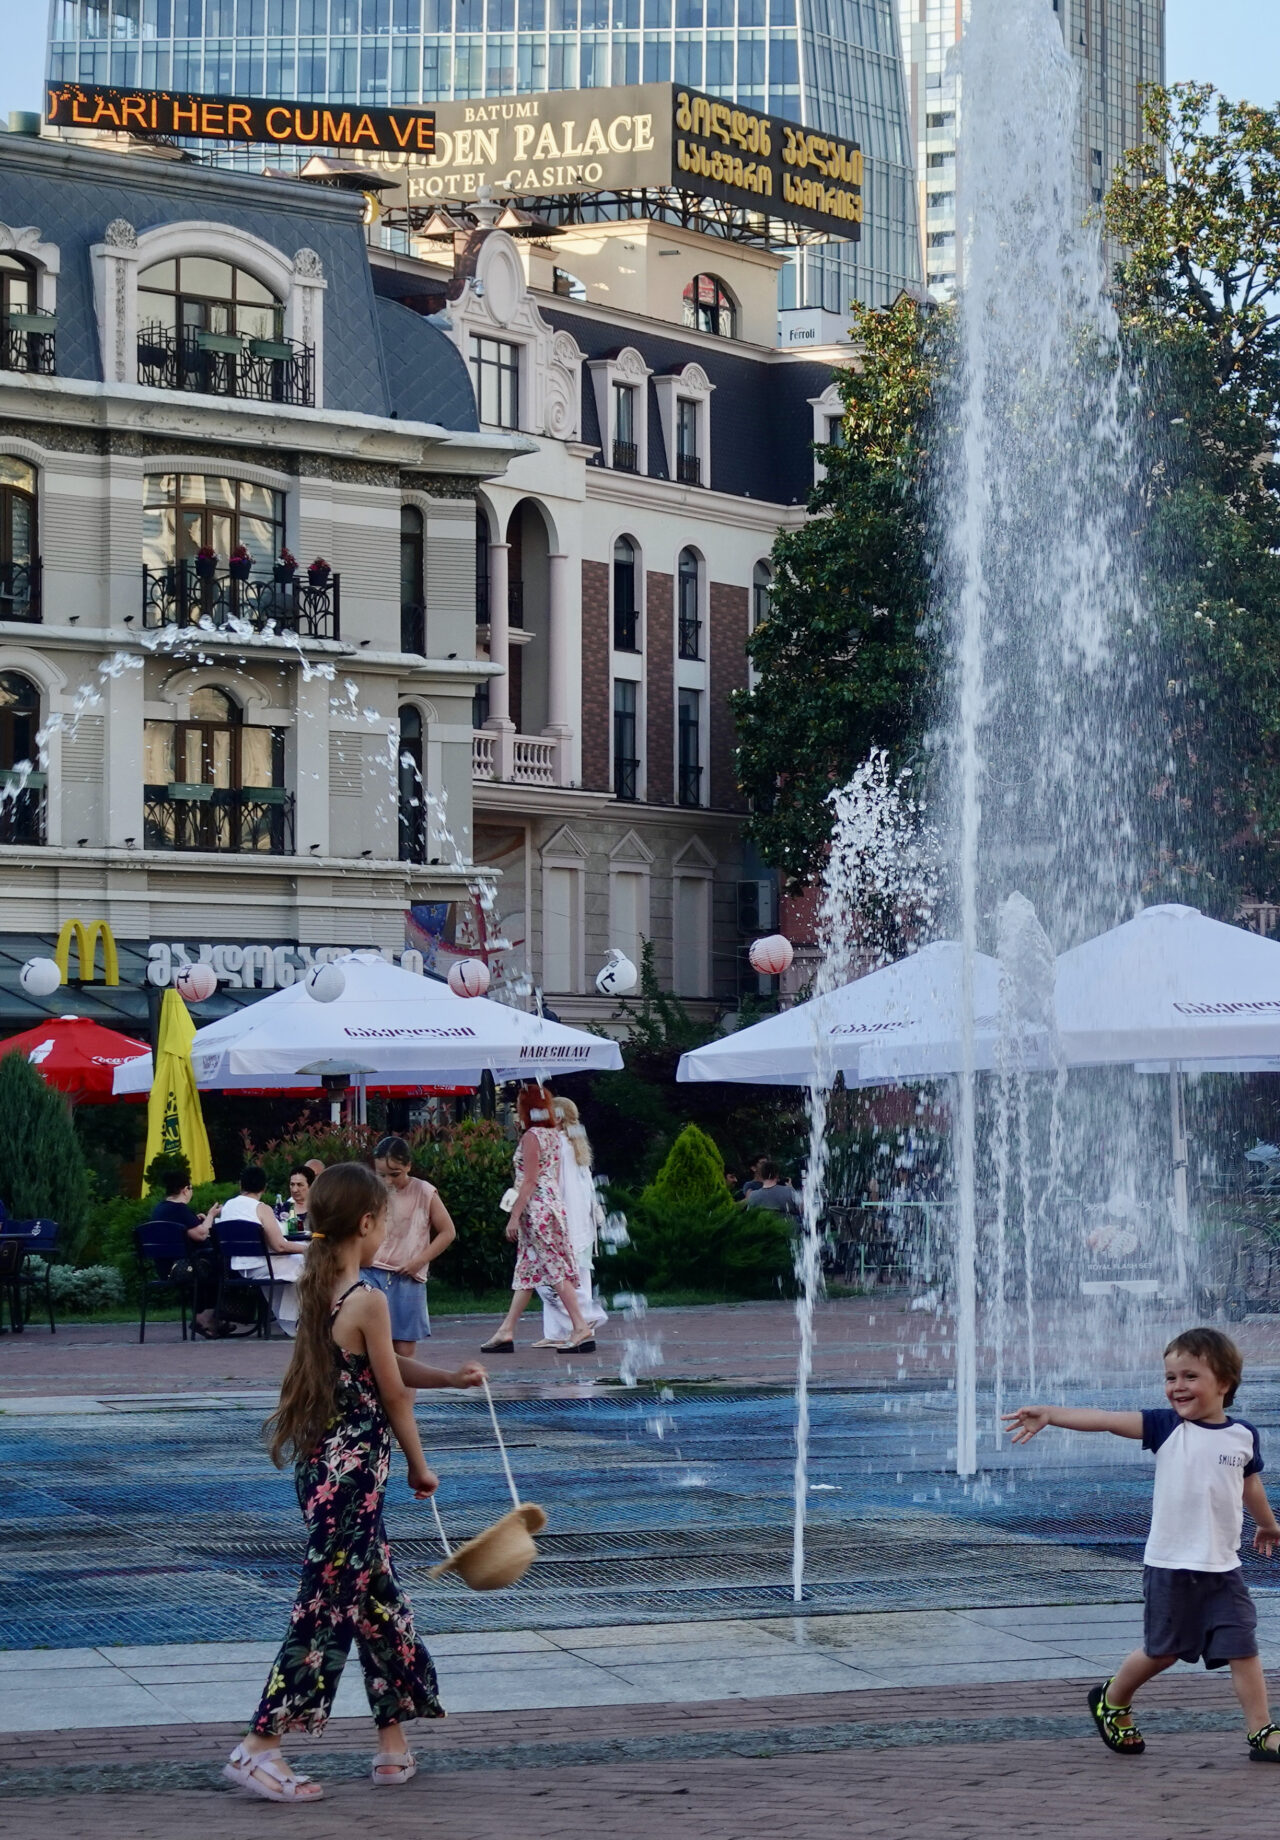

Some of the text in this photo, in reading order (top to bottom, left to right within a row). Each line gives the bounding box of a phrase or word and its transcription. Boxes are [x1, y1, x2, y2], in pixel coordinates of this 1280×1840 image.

[173, 100, 253, 137] HER
[266, 106, 380, 145] CUMA
[388, 115, 434, 149] VE
[464, 101, 540, 123] BATUMI
[513, 113, 656, 162] PALACE
[676, 91, 863, 187] გოლდენ პალასი
[408, 172, 486, 199] HOTEL
[507, 162, 604, 190] CASINO
[677, 139, 863, 224] სასტუმრო სამორინე
[789, 328, 816, 341] Ferroli
[147, 942, 424, 988] მადონაი
[519, 1045, 592, 1058] NABEGHLAVI
[1218, 1454, 1236, 1467] SMILE
